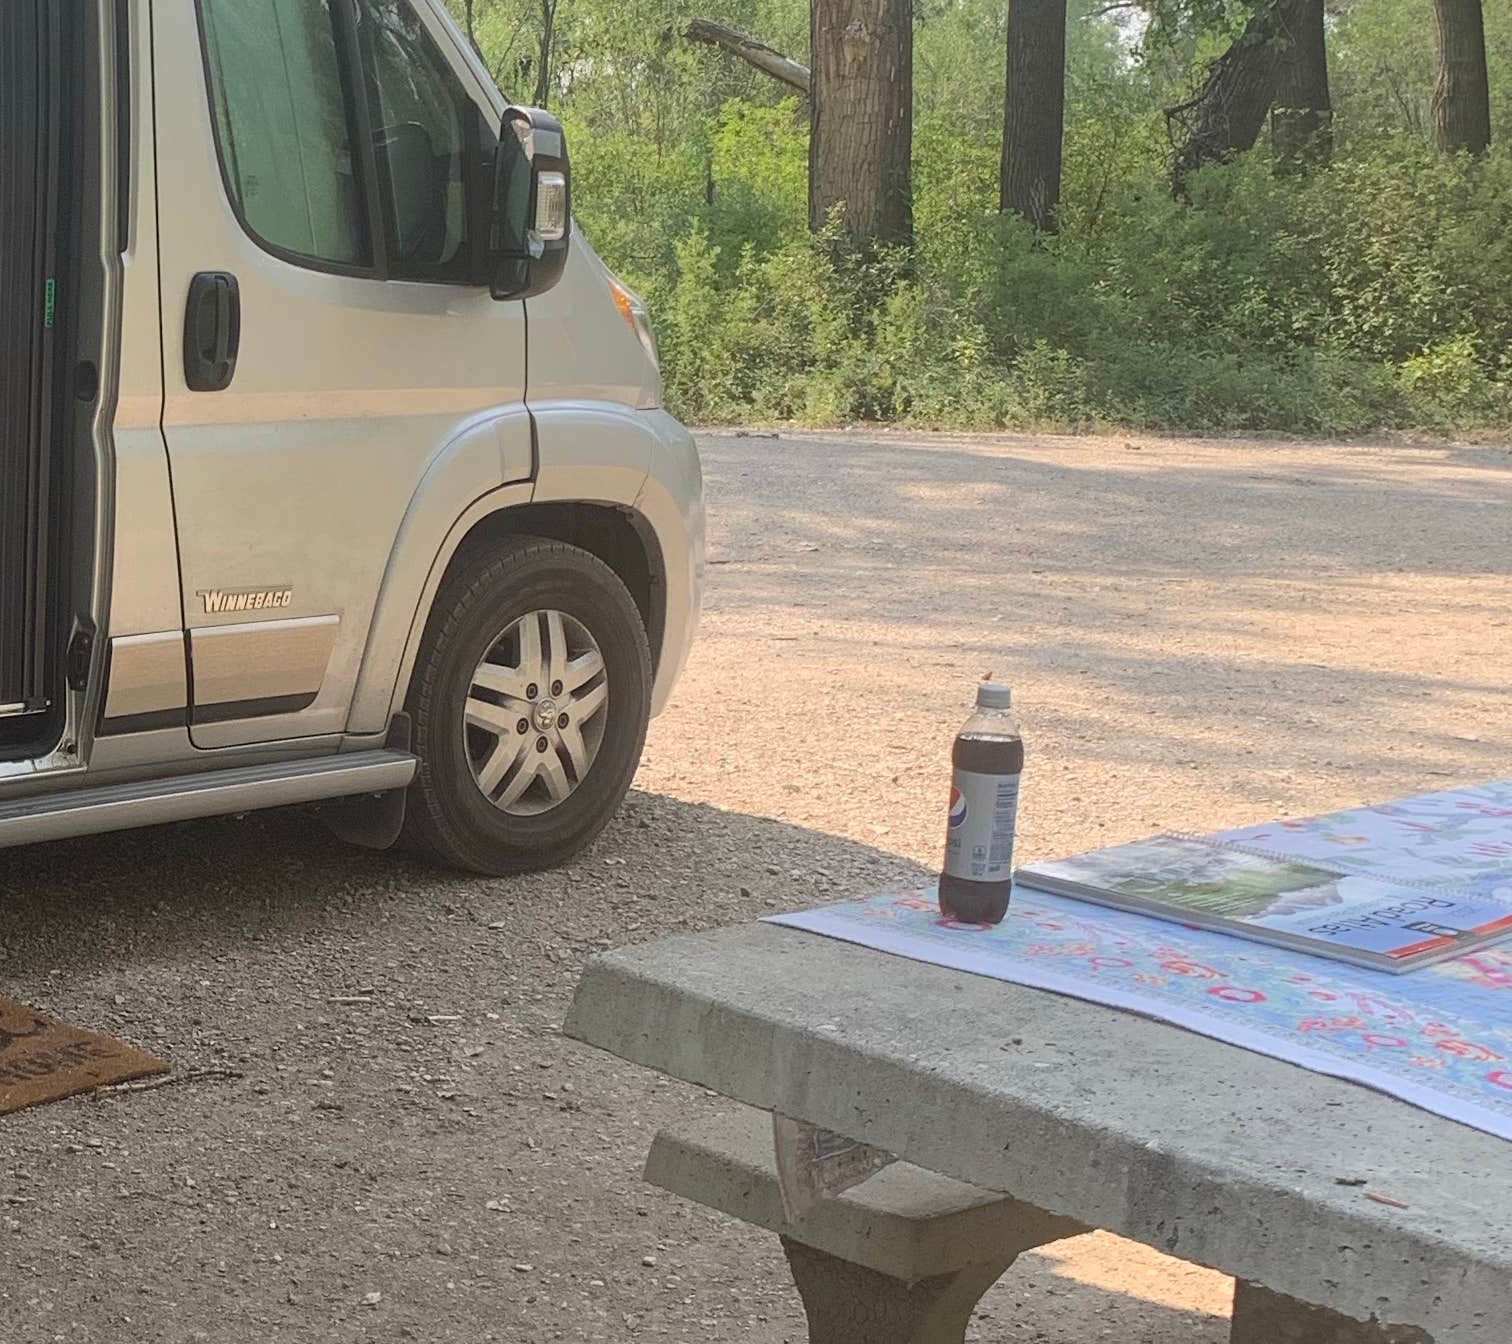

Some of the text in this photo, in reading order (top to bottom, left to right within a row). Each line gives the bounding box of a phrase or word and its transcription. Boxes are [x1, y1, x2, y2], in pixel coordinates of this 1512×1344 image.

[196, 586, 294, 614] WINNEBAGO
[1368, 896, 1456, 923] Road
[1308, 914, 1390, 936] Atlas
